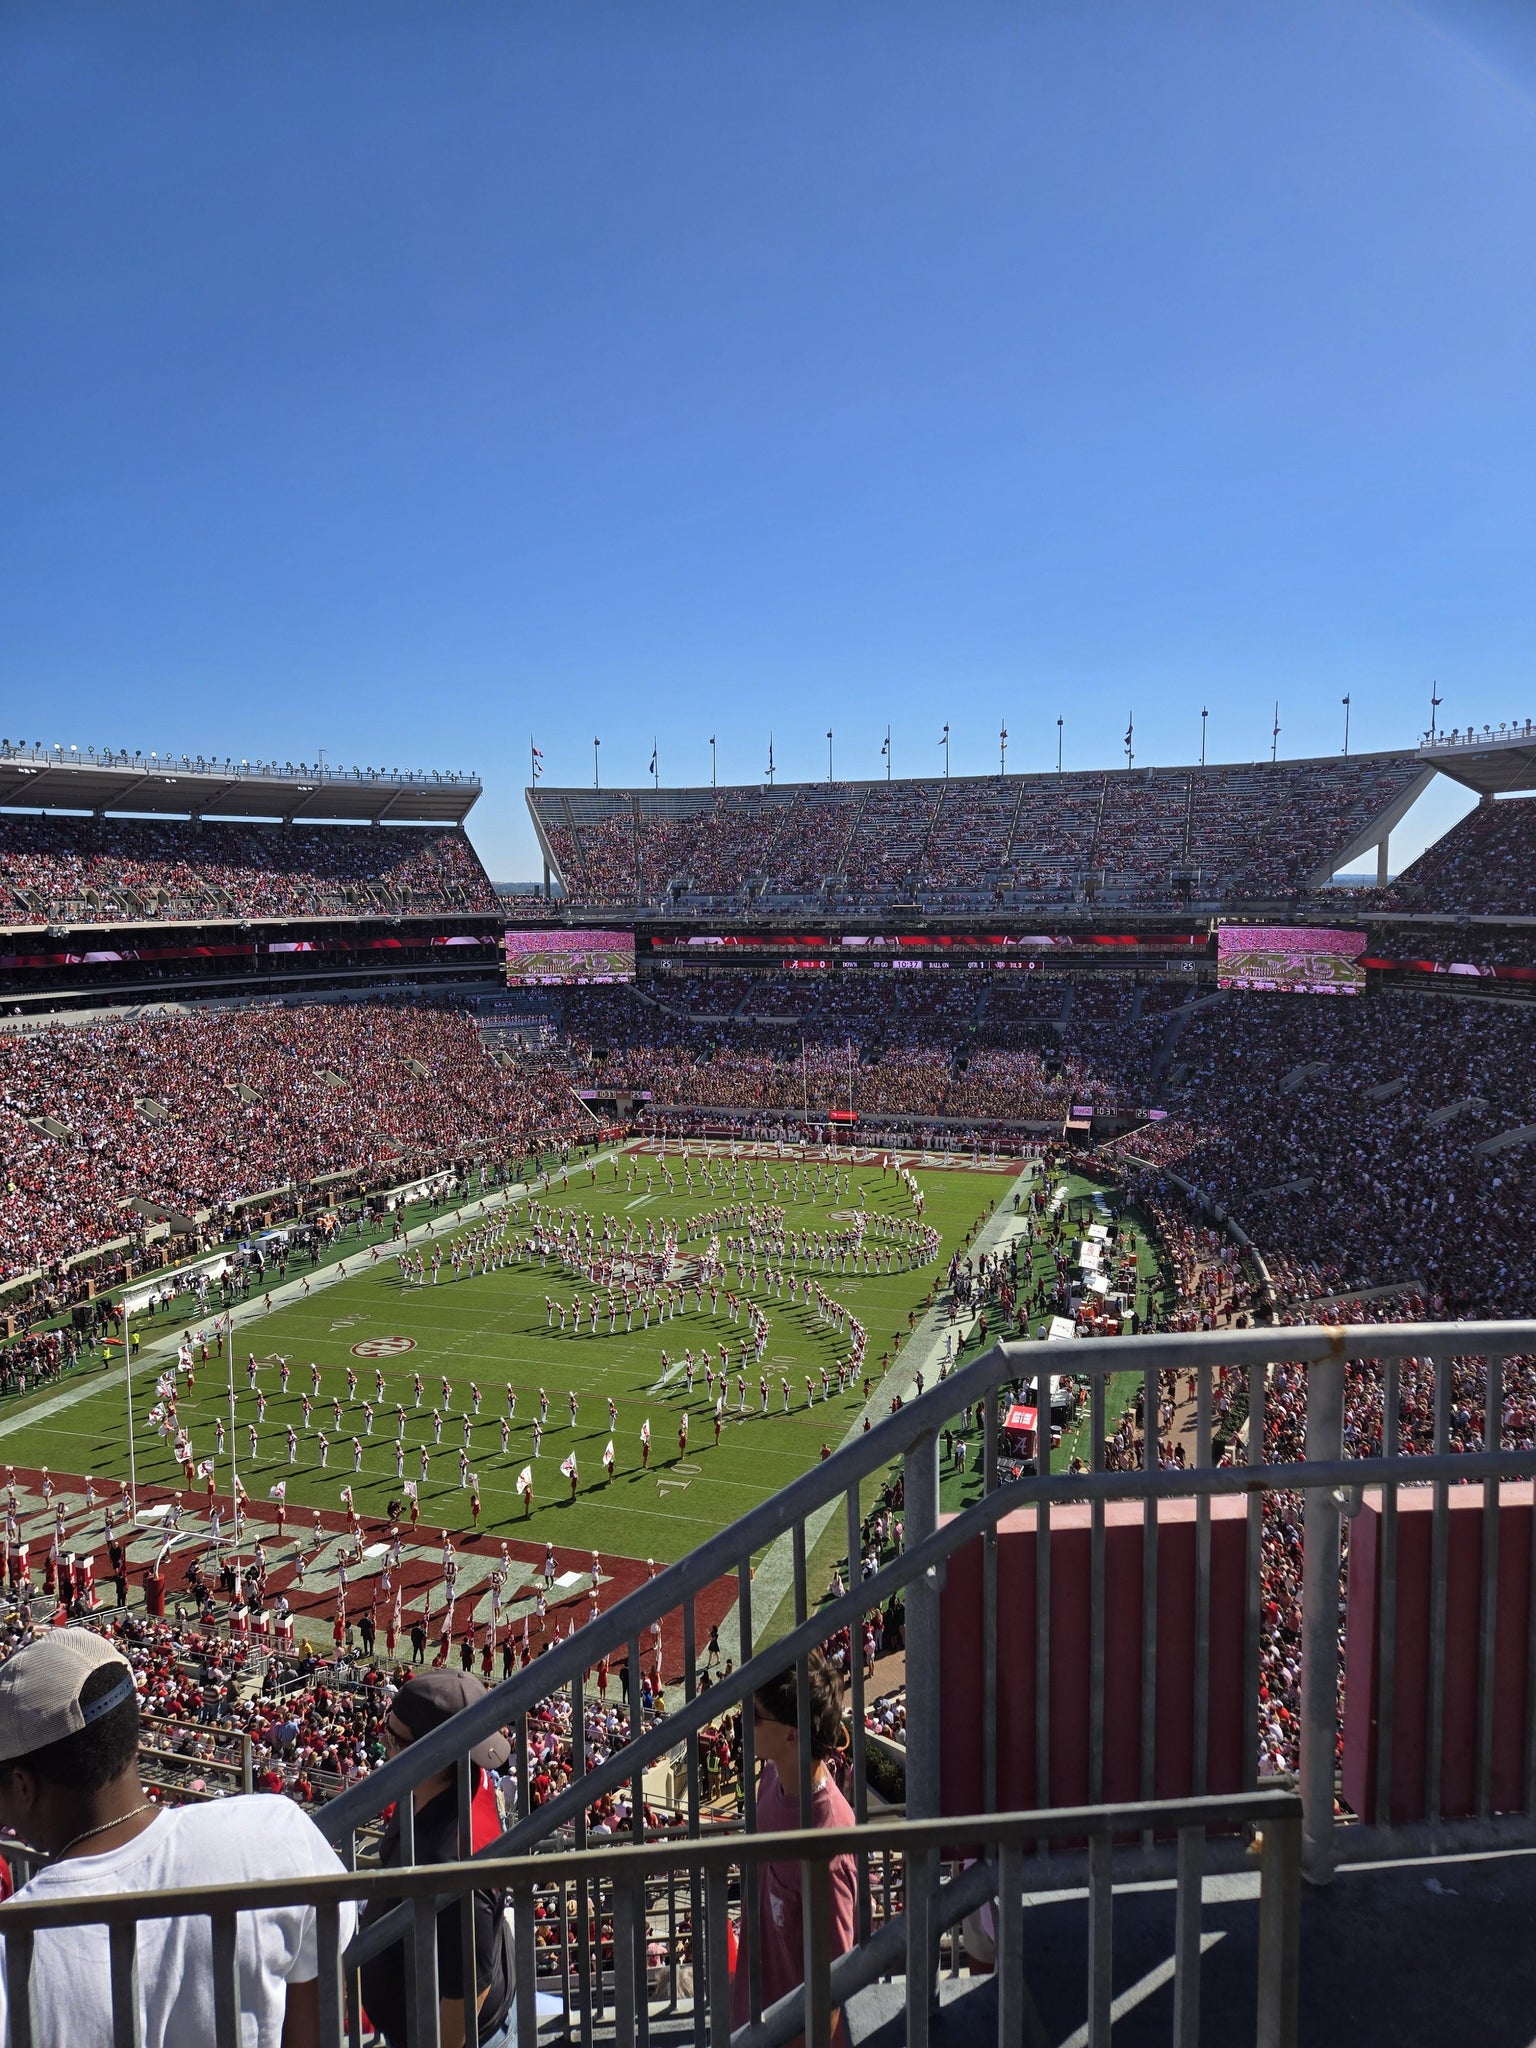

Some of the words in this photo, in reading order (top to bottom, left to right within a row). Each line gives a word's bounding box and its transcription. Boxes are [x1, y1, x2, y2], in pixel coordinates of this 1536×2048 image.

[1029, 961, 1035, 969] 0
[1183, 962, 1193, 970] 25
[1137, 1109, 1147, 1118] 25
[742, 1127, 803, 1142] ALABAM
[761, 1355, 798, 1373] 30
[655, 1463, 703, 1491] 10
